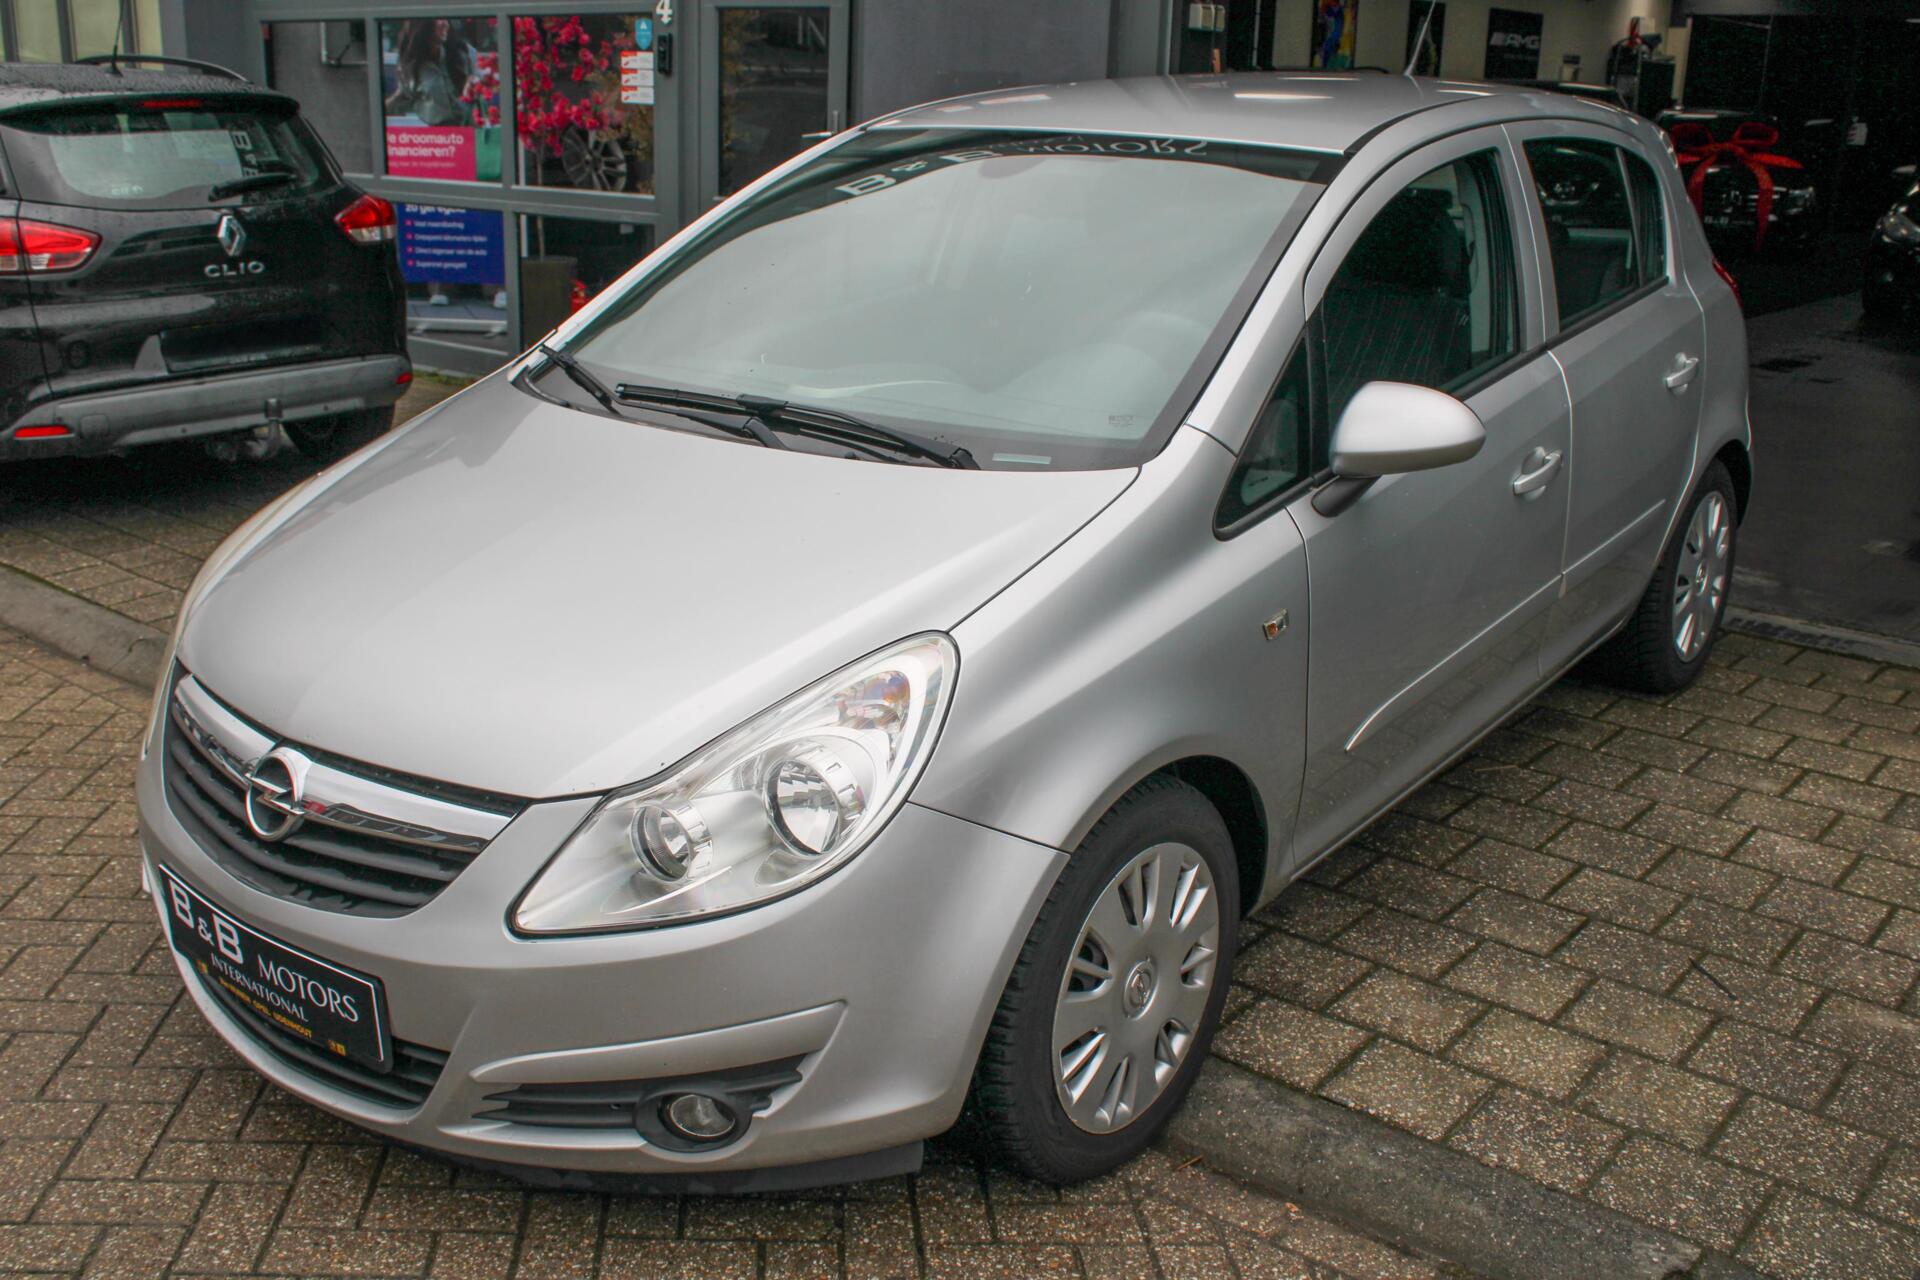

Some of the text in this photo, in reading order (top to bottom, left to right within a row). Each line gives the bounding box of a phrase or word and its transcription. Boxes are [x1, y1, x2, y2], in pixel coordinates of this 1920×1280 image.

[656, 0, 673, 24] 4
[398, 132, 464, 145] droomauto
[387, 145, 456, 158] inancieren?
[204, 260, 265, 278] CLIO
[211, 952, 309, 1023] INTERNATIONAL
[257, 953, 359, 1023] MOTORS
